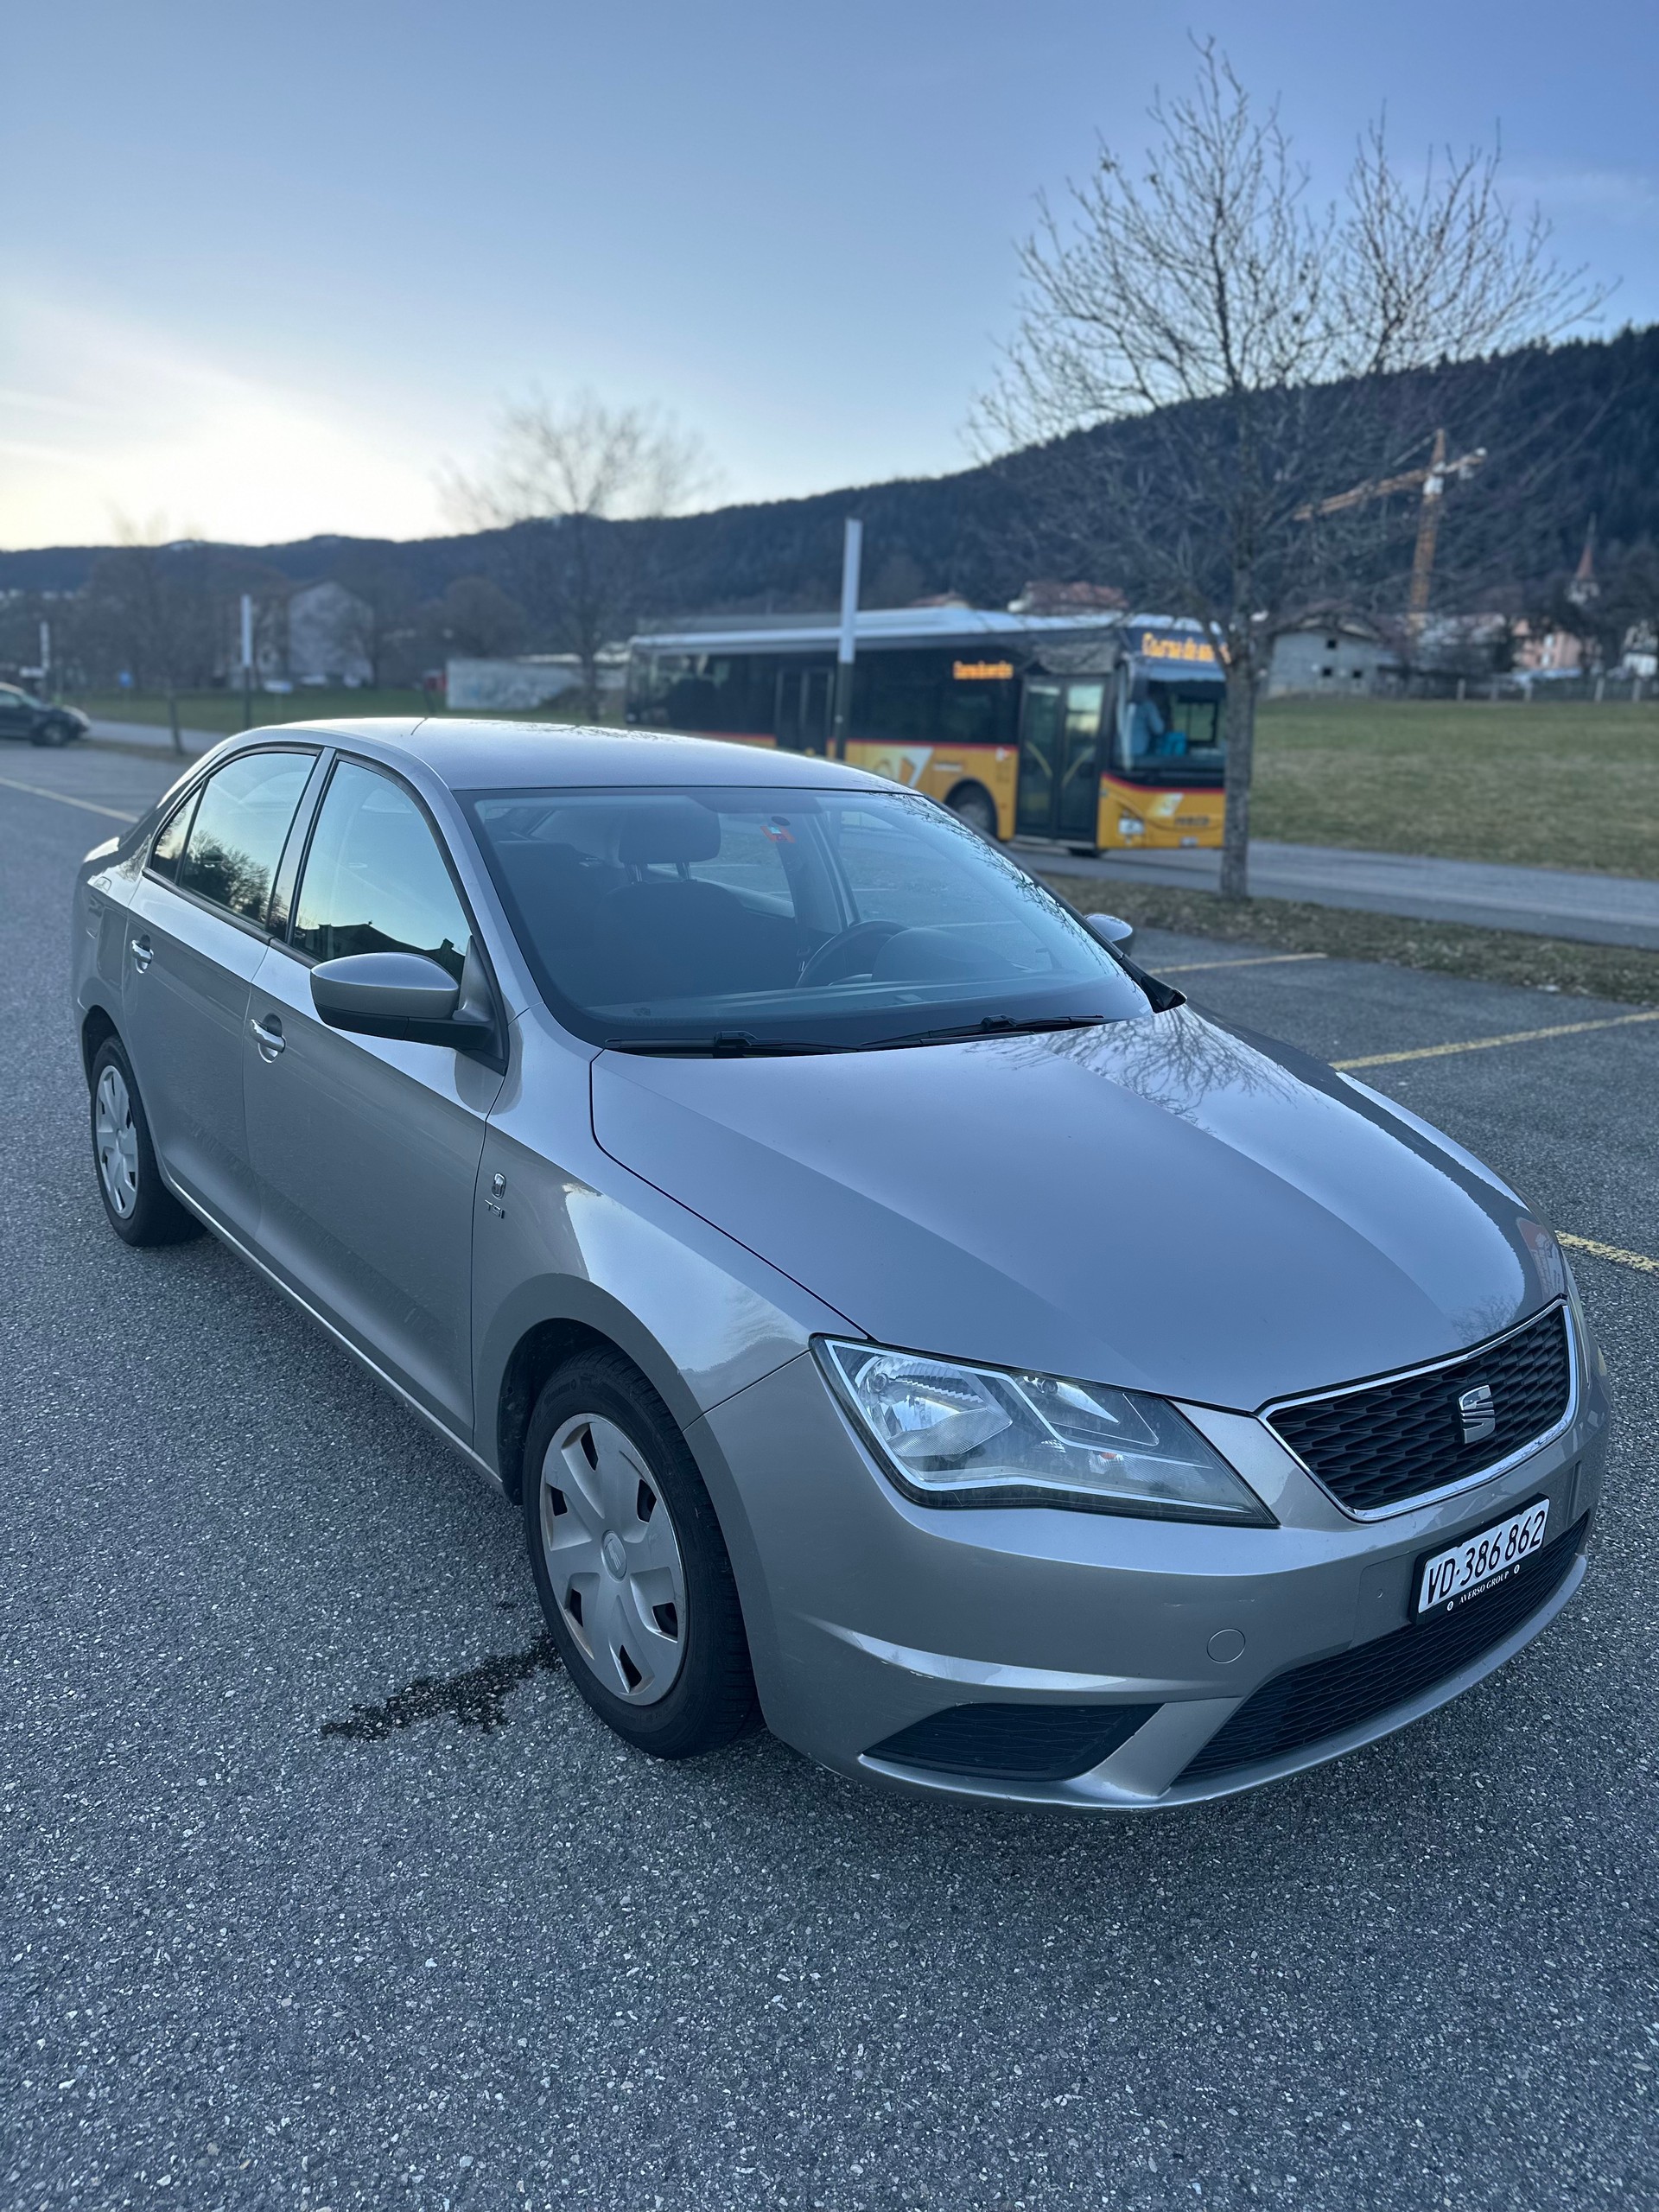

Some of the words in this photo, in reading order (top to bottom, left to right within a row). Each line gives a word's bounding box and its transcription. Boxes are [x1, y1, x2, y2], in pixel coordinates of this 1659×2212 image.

[1504, 1510, 1545, 1561] 862
[1459, 1584, 1485, 1605] AVERSO
[1486, 1571, 1510, 1589] GROUP
